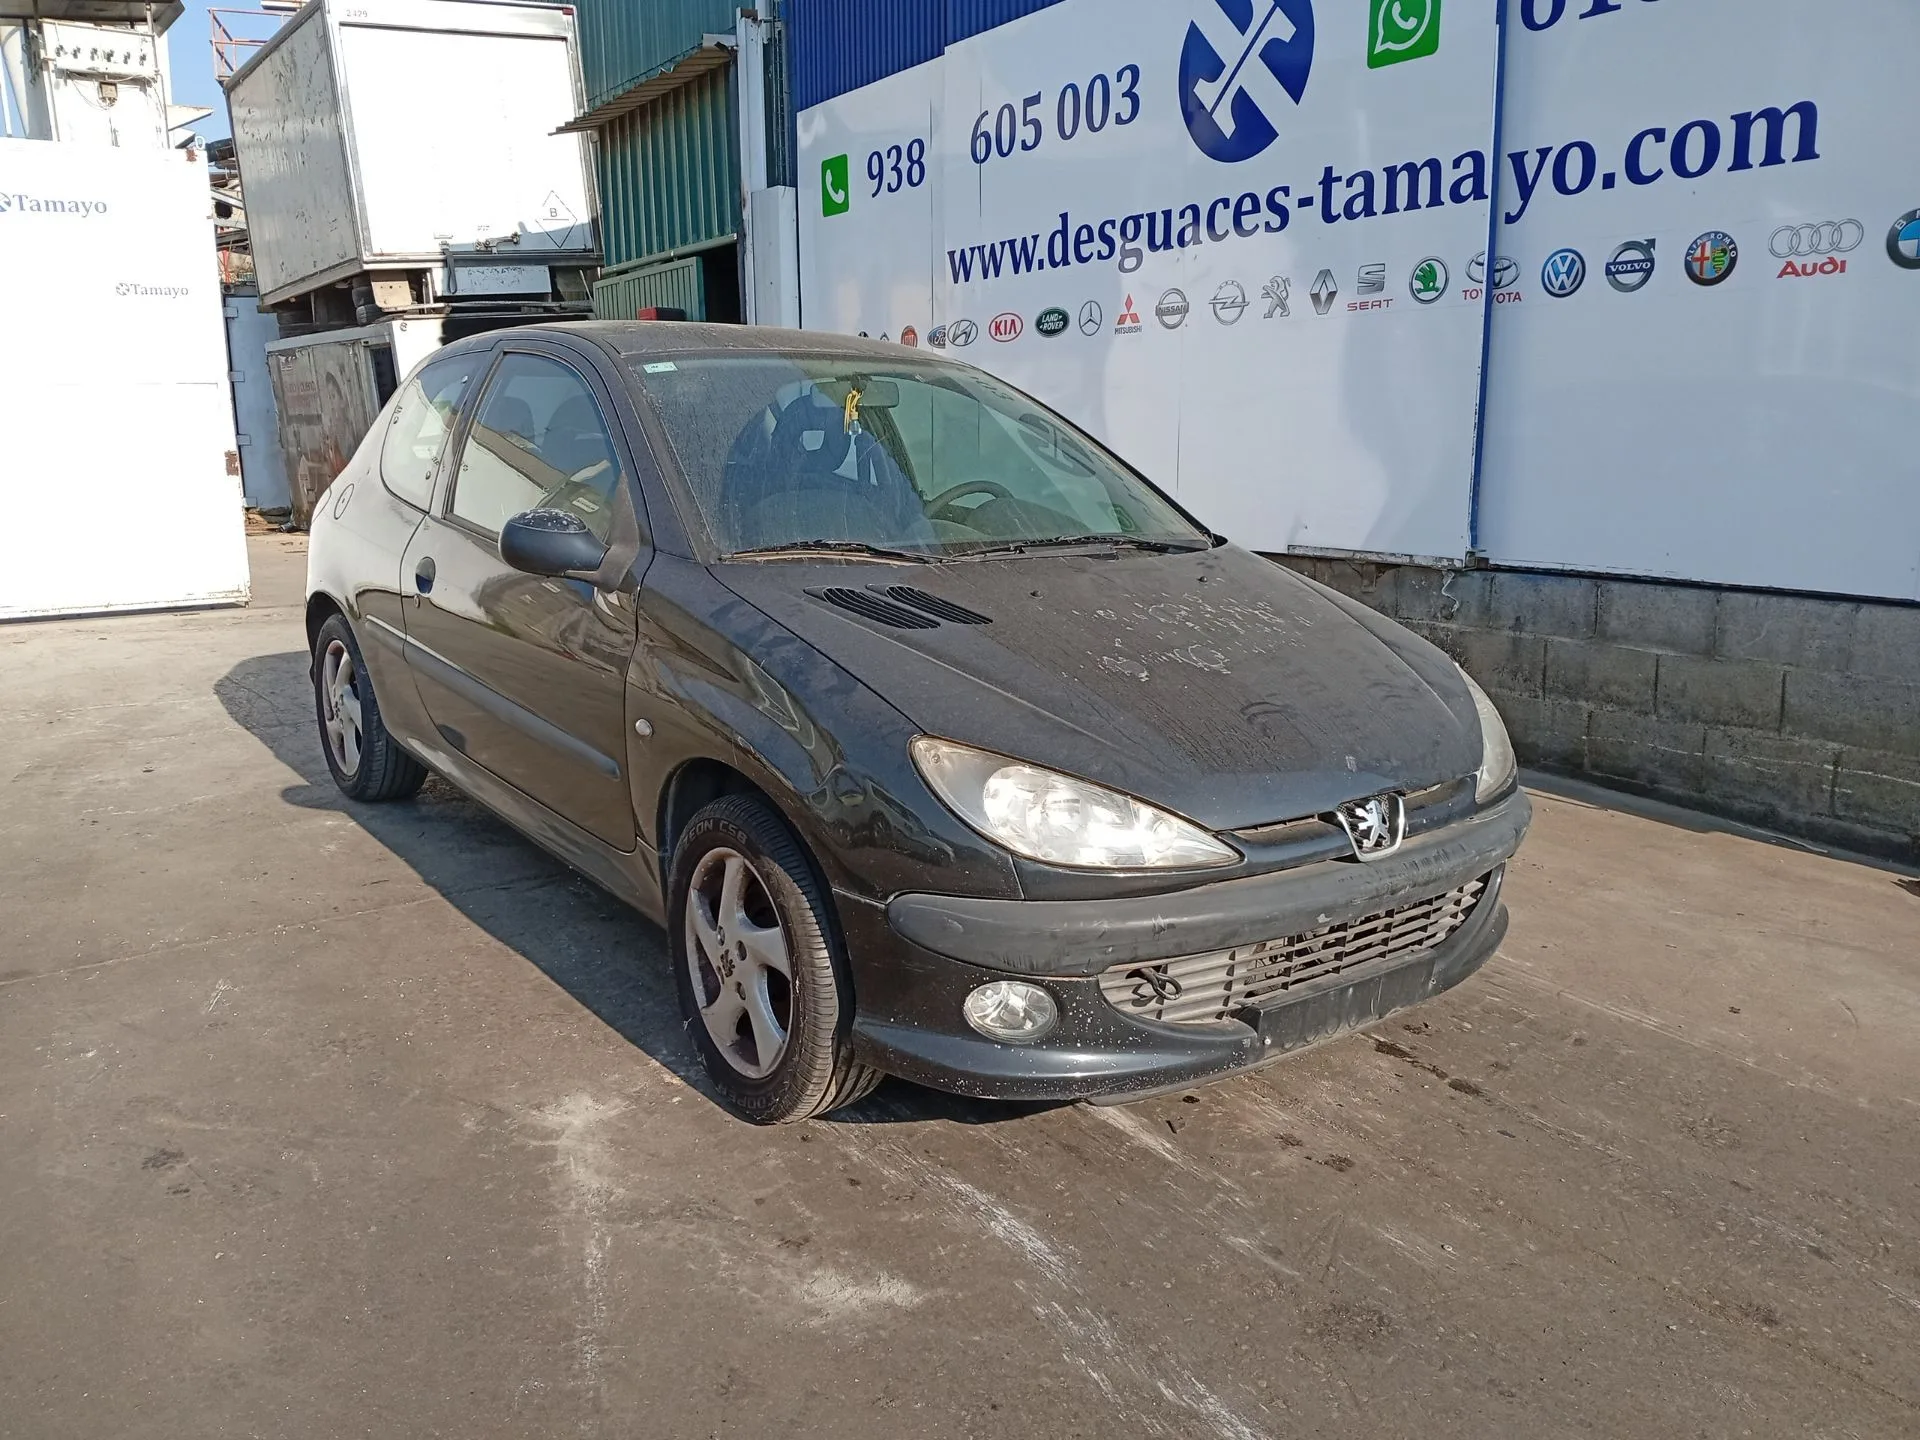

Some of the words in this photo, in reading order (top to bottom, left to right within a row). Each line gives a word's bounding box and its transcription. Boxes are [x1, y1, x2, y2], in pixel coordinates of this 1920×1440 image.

[866, 137, 926, 198] 938
[970, 90, 1042, 164] 605
[1057, 63, 1141, 141] 003
[947, 99, 1821, 285] www.desguaces-tamayo.com
[12, 193, 108, 218] Tamayo
[1686, 238, 1704, 262] ALFA
[1709, 232, 1737, 258] ROMEO
[1608, 261, 1651, 272] VOLVO
[1775, 256, 1847, 279] Audi
[130, 283, 189, 299] Tamayo
[1158, 305, 1187, 314] NISSAN
[1346, 298, 1394, 312] SEAT
[1041, 314, 1059, 323] LAND
[1043, 320, 1063, 331] ROVER
[994, 318, 1018, 337] KIA
[1114, 325, 1143, 335] MITSUBISHI
